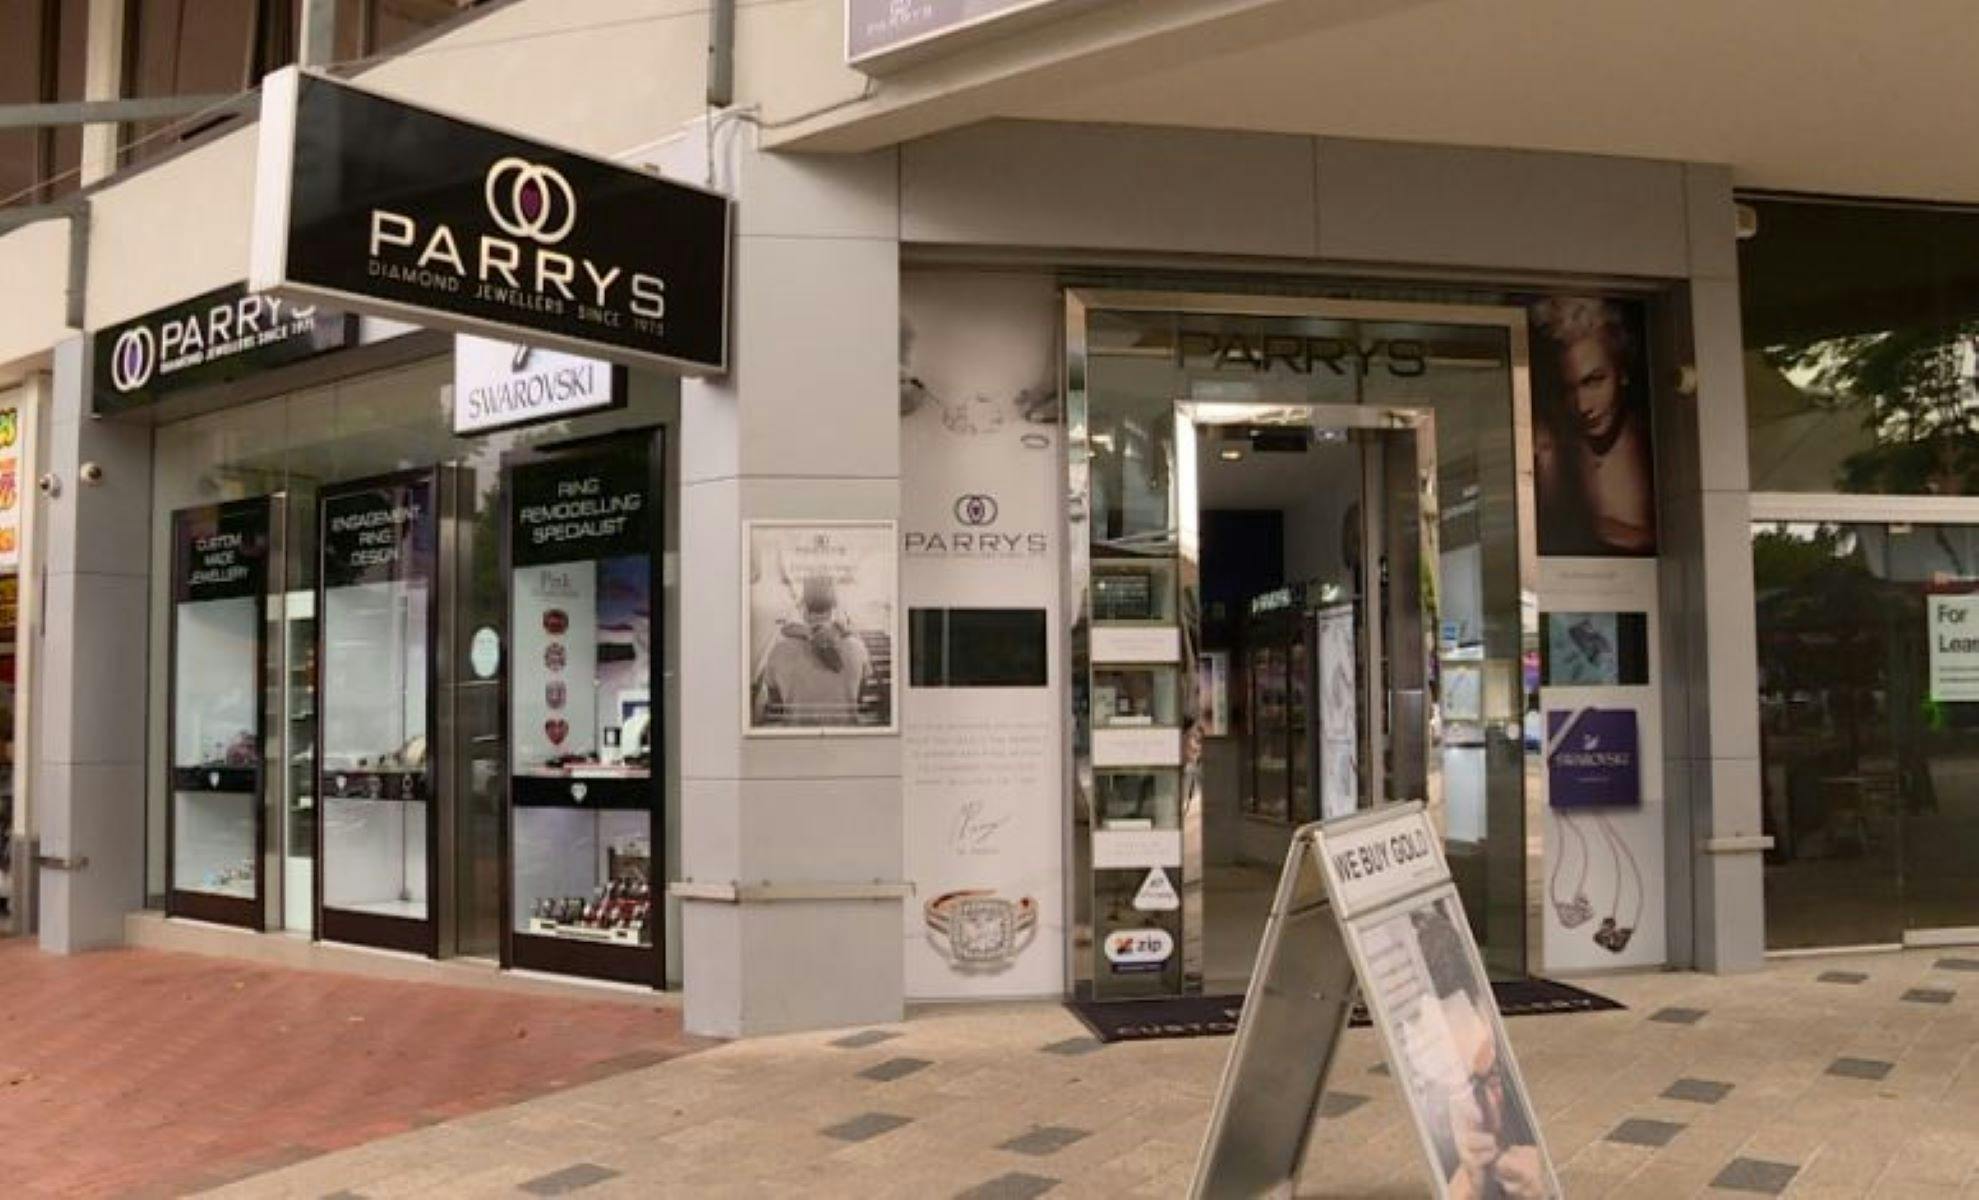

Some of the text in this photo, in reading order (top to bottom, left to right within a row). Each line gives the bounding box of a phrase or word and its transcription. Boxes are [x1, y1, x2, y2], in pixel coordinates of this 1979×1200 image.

[368, 209, 665, 319] PARRYS
[368, 260, 460, 293] DIAMOND
[475, 283, 564, 315] JEWELLERS
[578, 304, 621, 328] SINCE
[1178, 332, 1427, 377] PARRYS
[469, 365, 593, 419] SWAROVSKI
[558, 478, 601, 498] RING
[331, 504, 421, 532] ENGAGEMENT
[520, 493, 642, 523] REMODELLING
[195, 533, 242, 551] CUSTOM
[359, 528, 393, 546] RING
[533, 517, 628, 544] SPECIALIST
[904, 532, 1047, 552] PARRYS
[350, 546, 398, 567] DESIGN
[1937, 604, 1967, 623] For
[1333, 828, 1428, 882] WE BUY GOLD
[1137, 932, 1162, 953] zip
